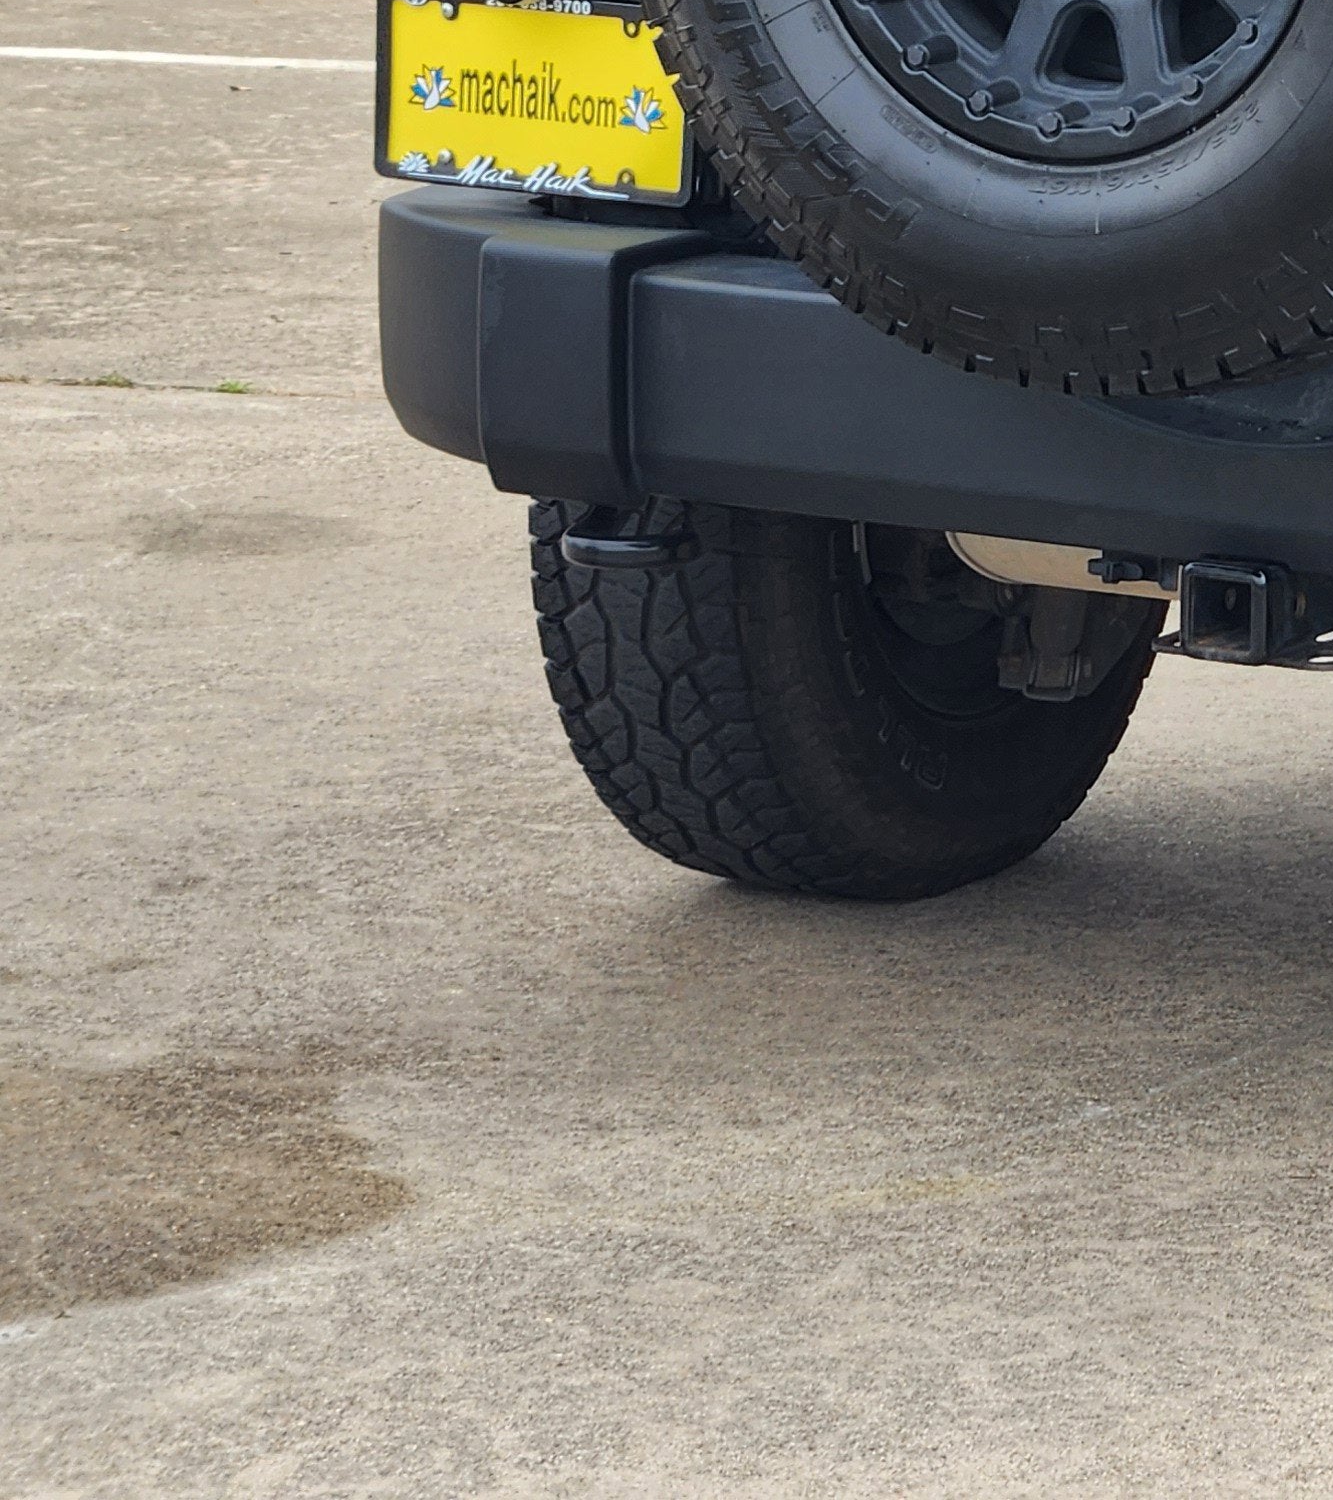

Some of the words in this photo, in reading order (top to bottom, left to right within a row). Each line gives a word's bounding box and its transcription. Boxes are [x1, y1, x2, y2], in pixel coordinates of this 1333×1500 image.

[458, 59, 617, 129] machaik.com
[452, 154, 522, 187] Mac
[522, 161, 612, 197] Haik
